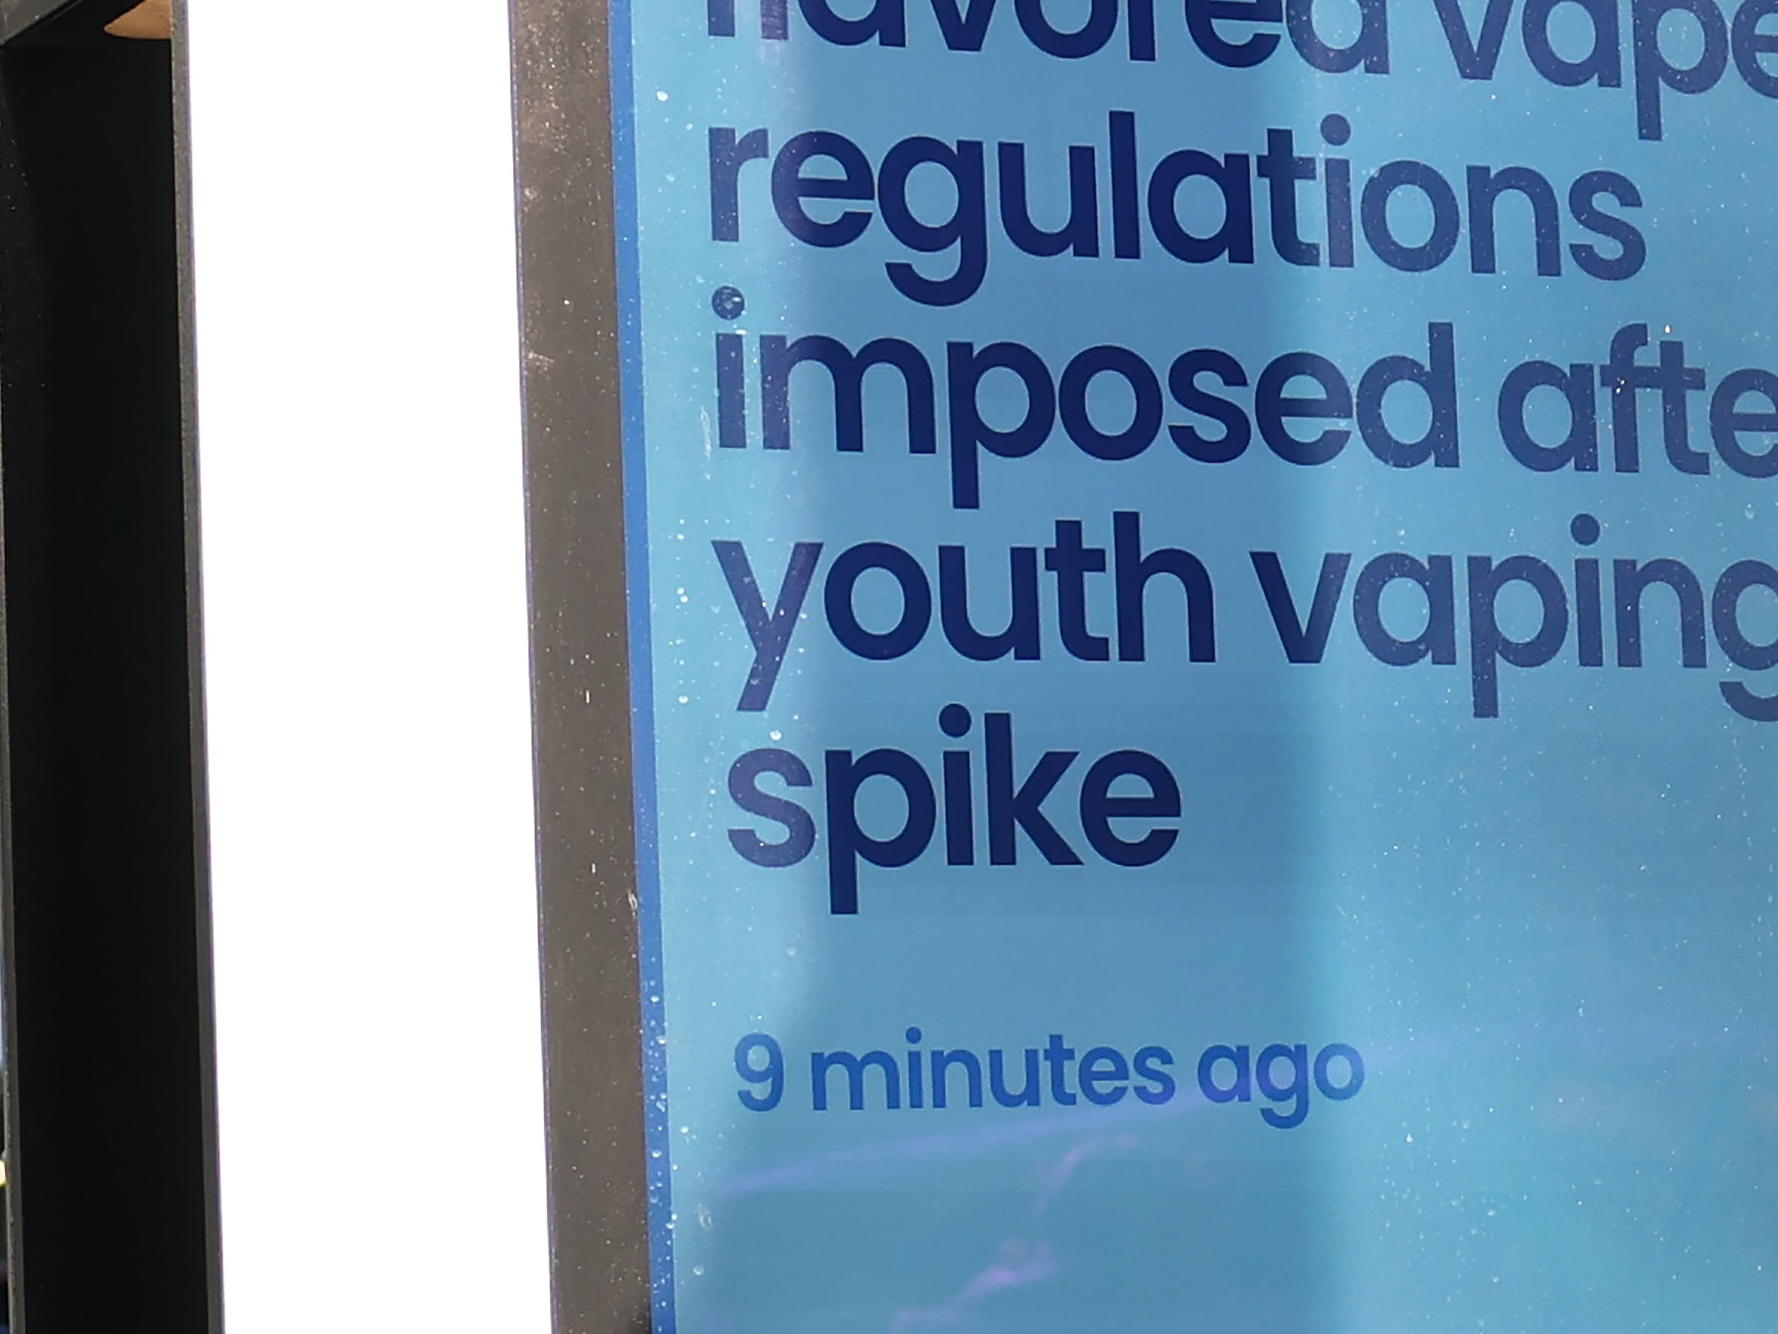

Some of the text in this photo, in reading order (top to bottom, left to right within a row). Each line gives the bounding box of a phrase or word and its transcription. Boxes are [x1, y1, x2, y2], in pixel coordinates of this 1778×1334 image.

[708, 110, 1647, 306] regulations
[710, 286, 1460, 509] imposed
[711, 511, 1215, 711] youth
[727, 703, 1181, 915] spike
[734, 1027, 1365, 1129] 9 minutes ago
